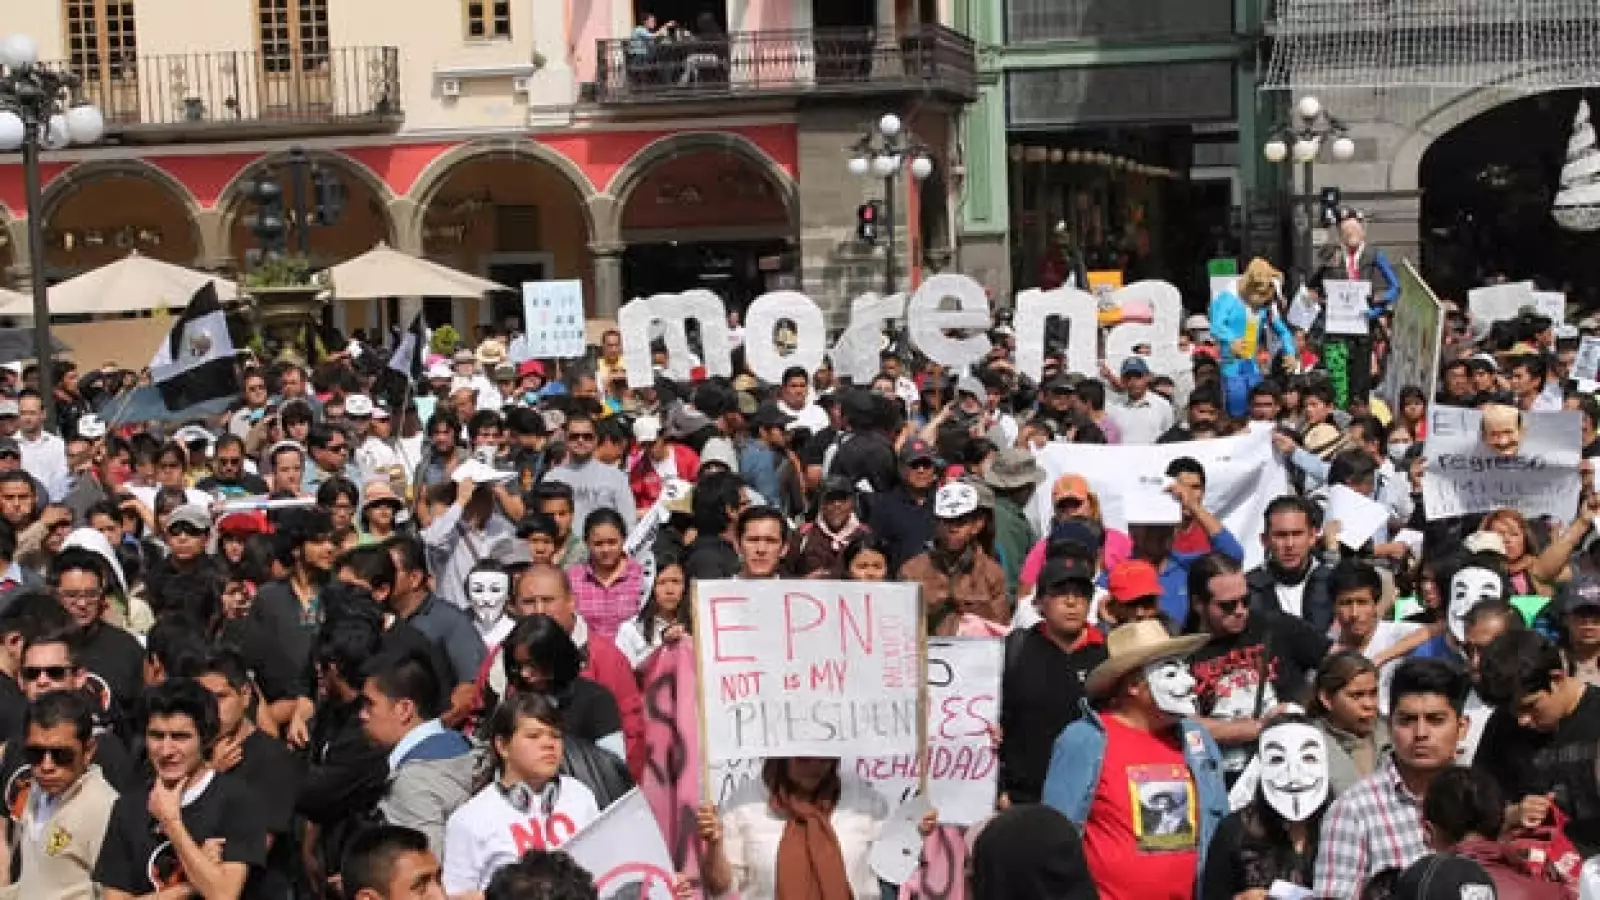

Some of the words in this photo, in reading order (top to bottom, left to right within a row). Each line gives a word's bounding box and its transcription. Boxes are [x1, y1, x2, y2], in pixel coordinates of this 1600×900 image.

[617, 273, 1197, 400] morena
[709, 591, 873, 662] EPN
[721, 671, 764, 703] NOT
[809, 656, 847, 693] MY
